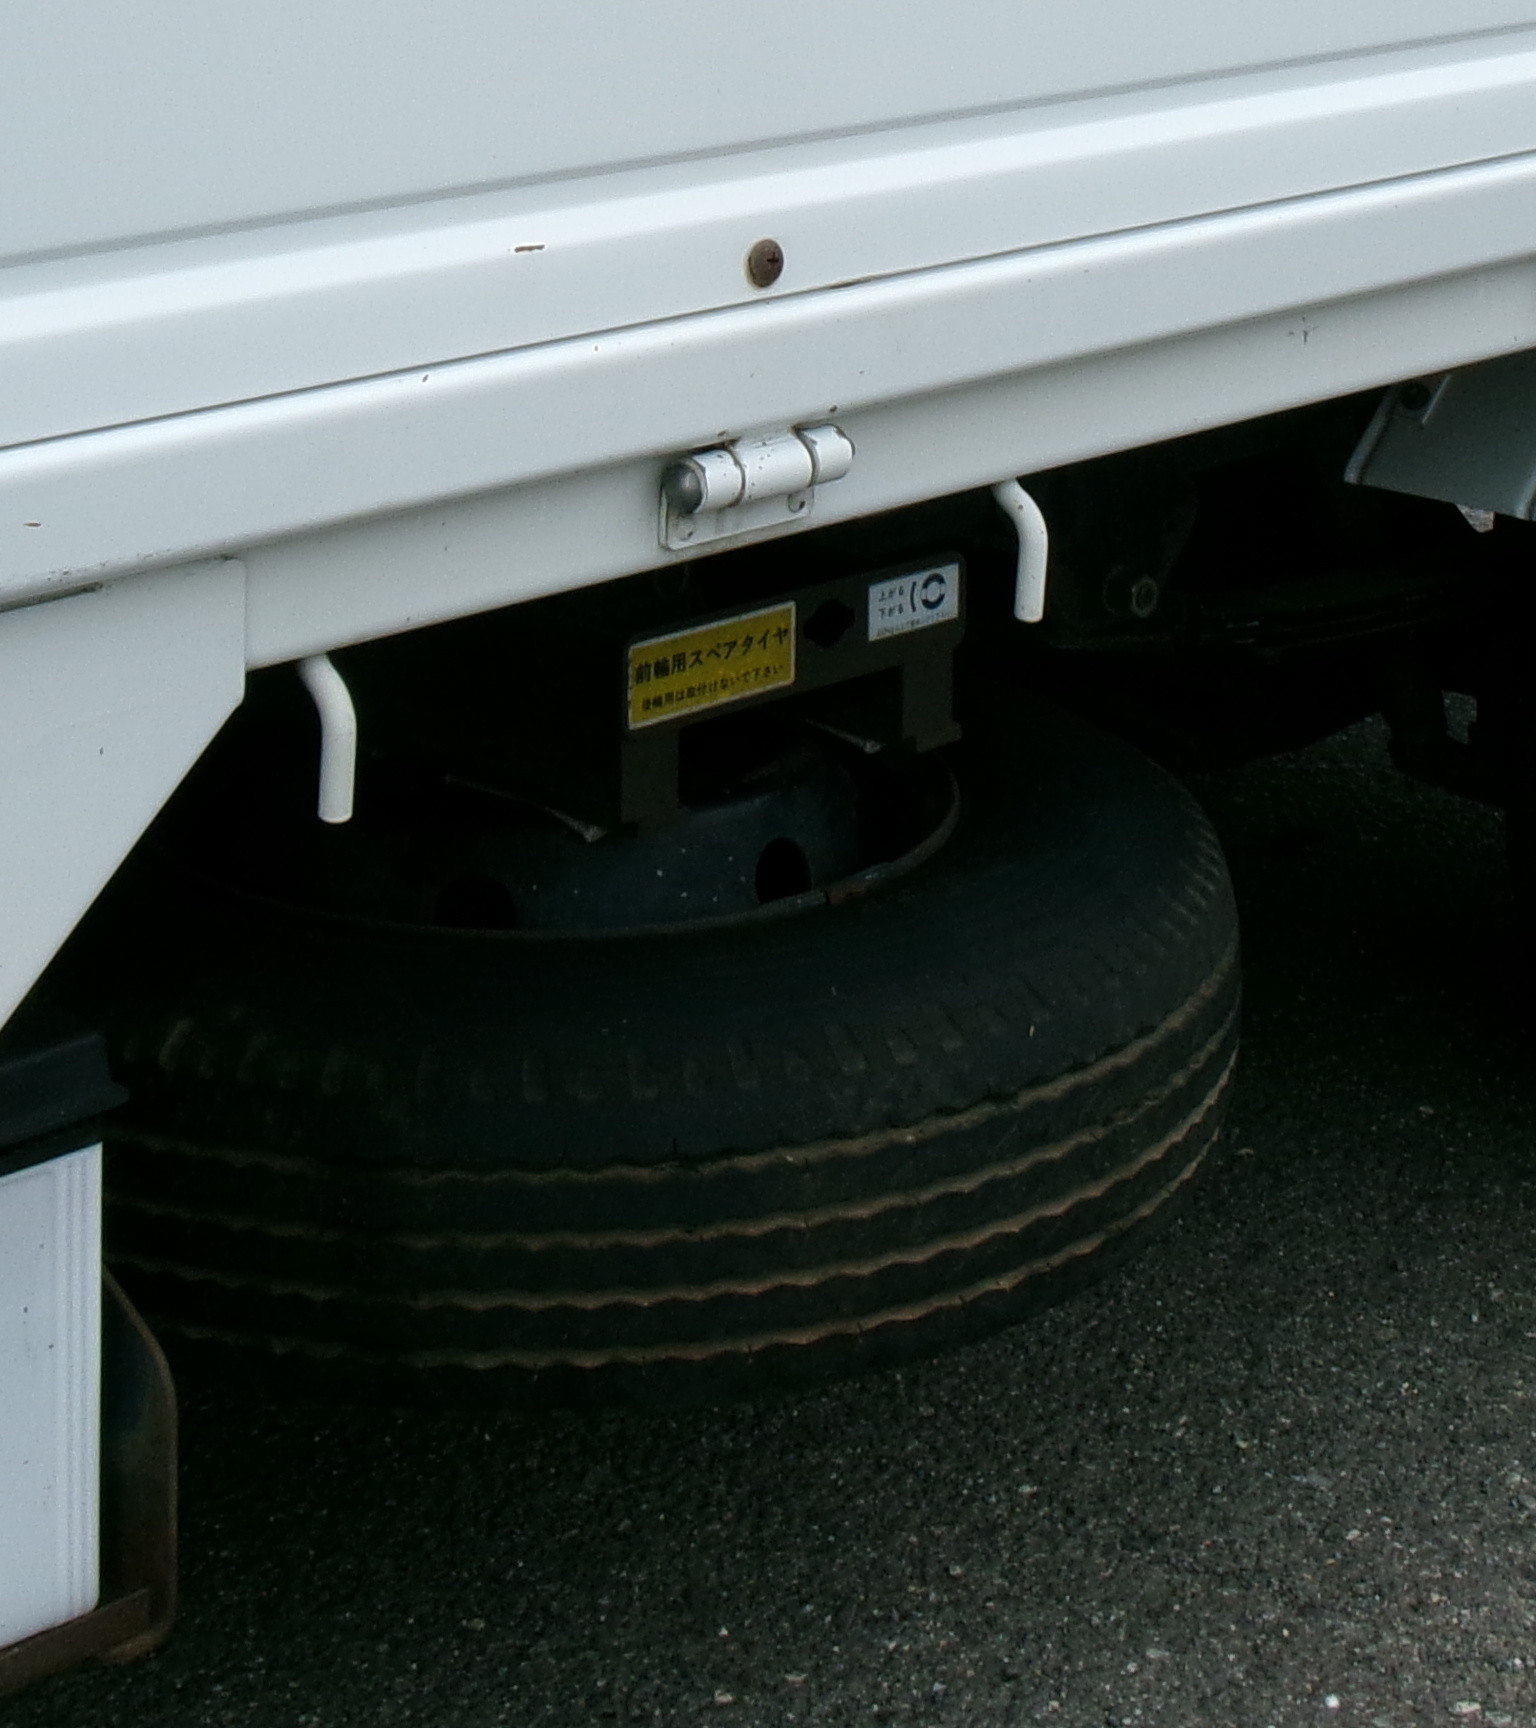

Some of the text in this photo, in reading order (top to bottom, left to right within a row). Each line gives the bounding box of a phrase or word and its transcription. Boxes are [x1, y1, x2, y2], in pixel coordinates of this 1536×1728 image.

[635, 625, 789, 685] 前輪用スペアタイヤ
